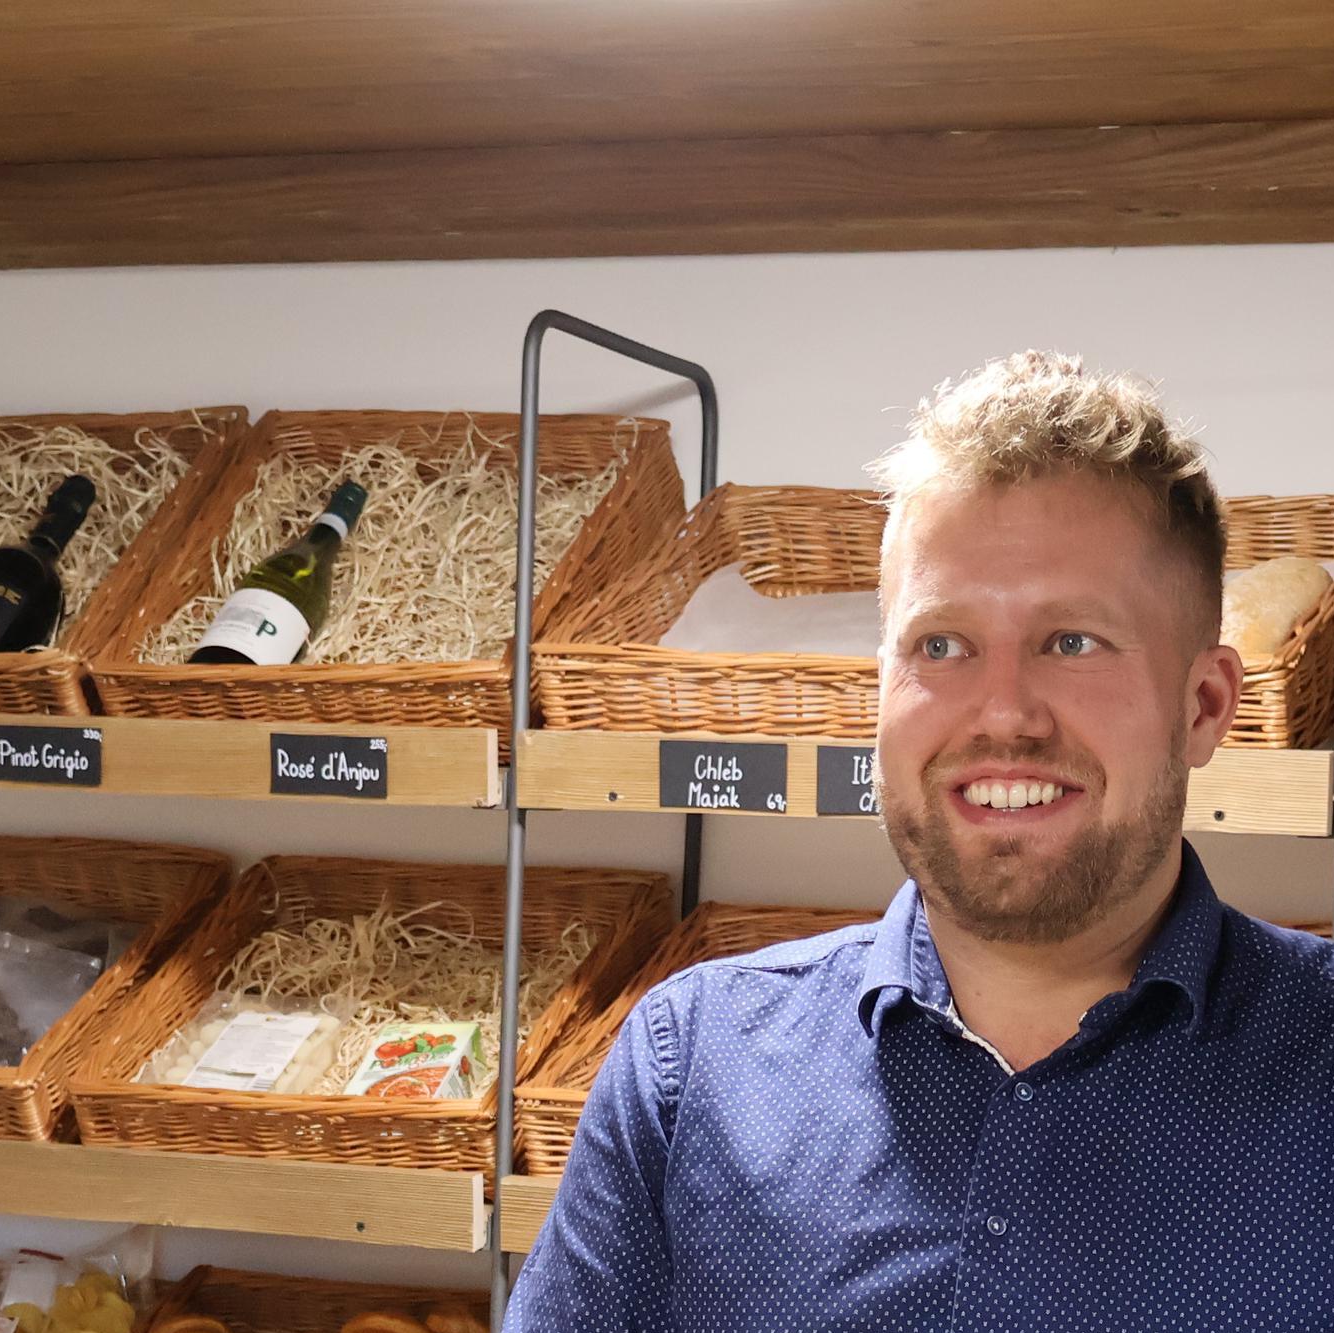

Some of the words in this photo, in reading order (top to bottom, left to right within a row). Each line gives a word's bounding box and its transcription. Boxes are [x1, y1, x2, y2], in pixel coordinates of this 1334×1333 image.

[41, 743, 89, 779] Grigio
[277, 748, 315, 779] Rosé
[321, 751, 380, 791] d'Anjou
[693, 754, 743, 782] Chléb
[687, 781, 741, 809] Maják
